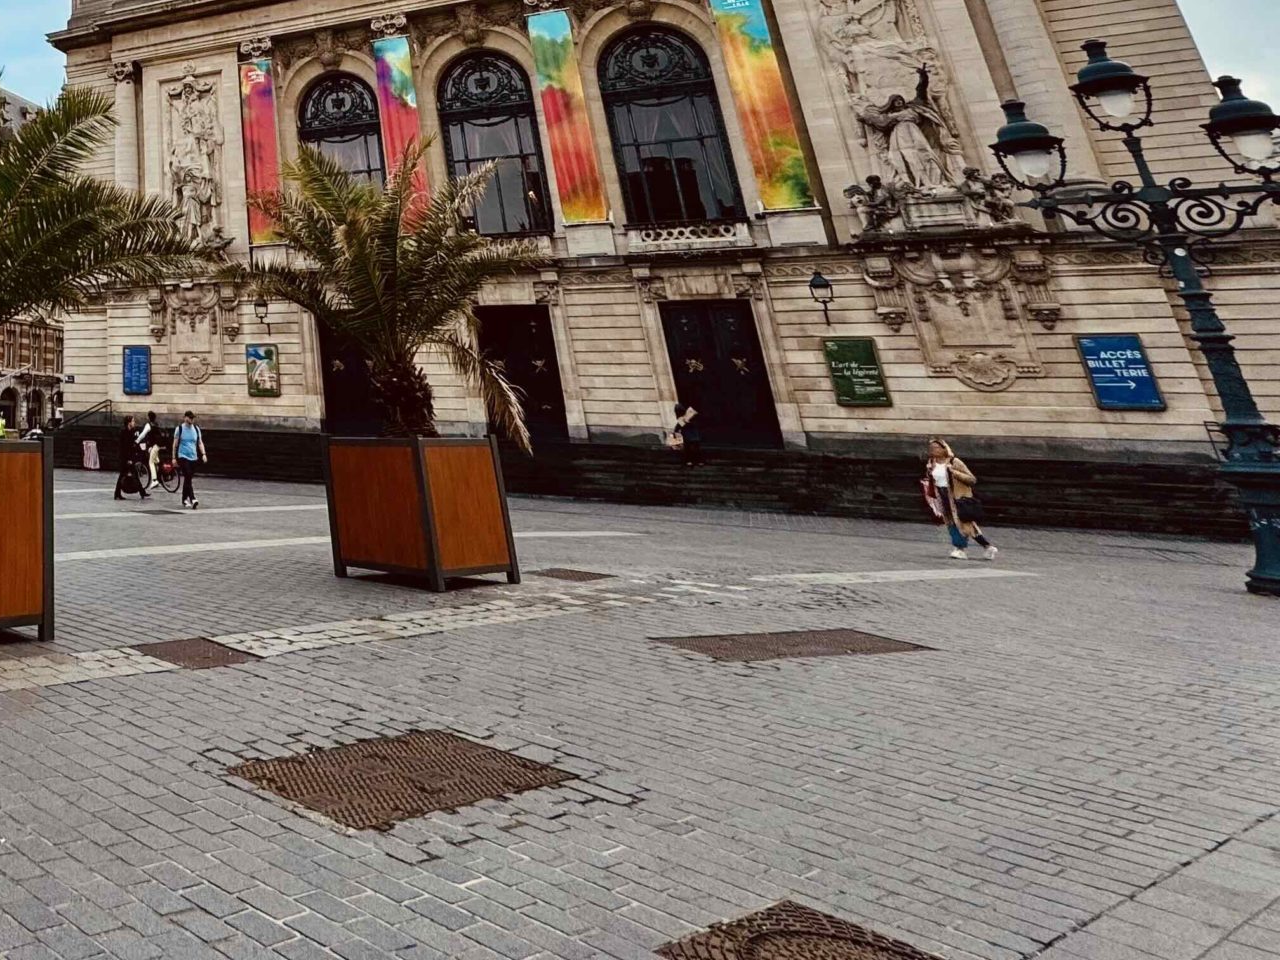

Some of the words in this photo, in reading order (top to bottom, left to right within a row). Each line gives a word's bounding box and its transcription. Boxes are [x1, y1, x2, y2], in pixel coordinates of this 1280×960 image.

[1100, 349, 1142, 359] ACCÈS
[1087, 360, 1126, 368] BILLET
[1114, 369, 1150, 377] TERIE
